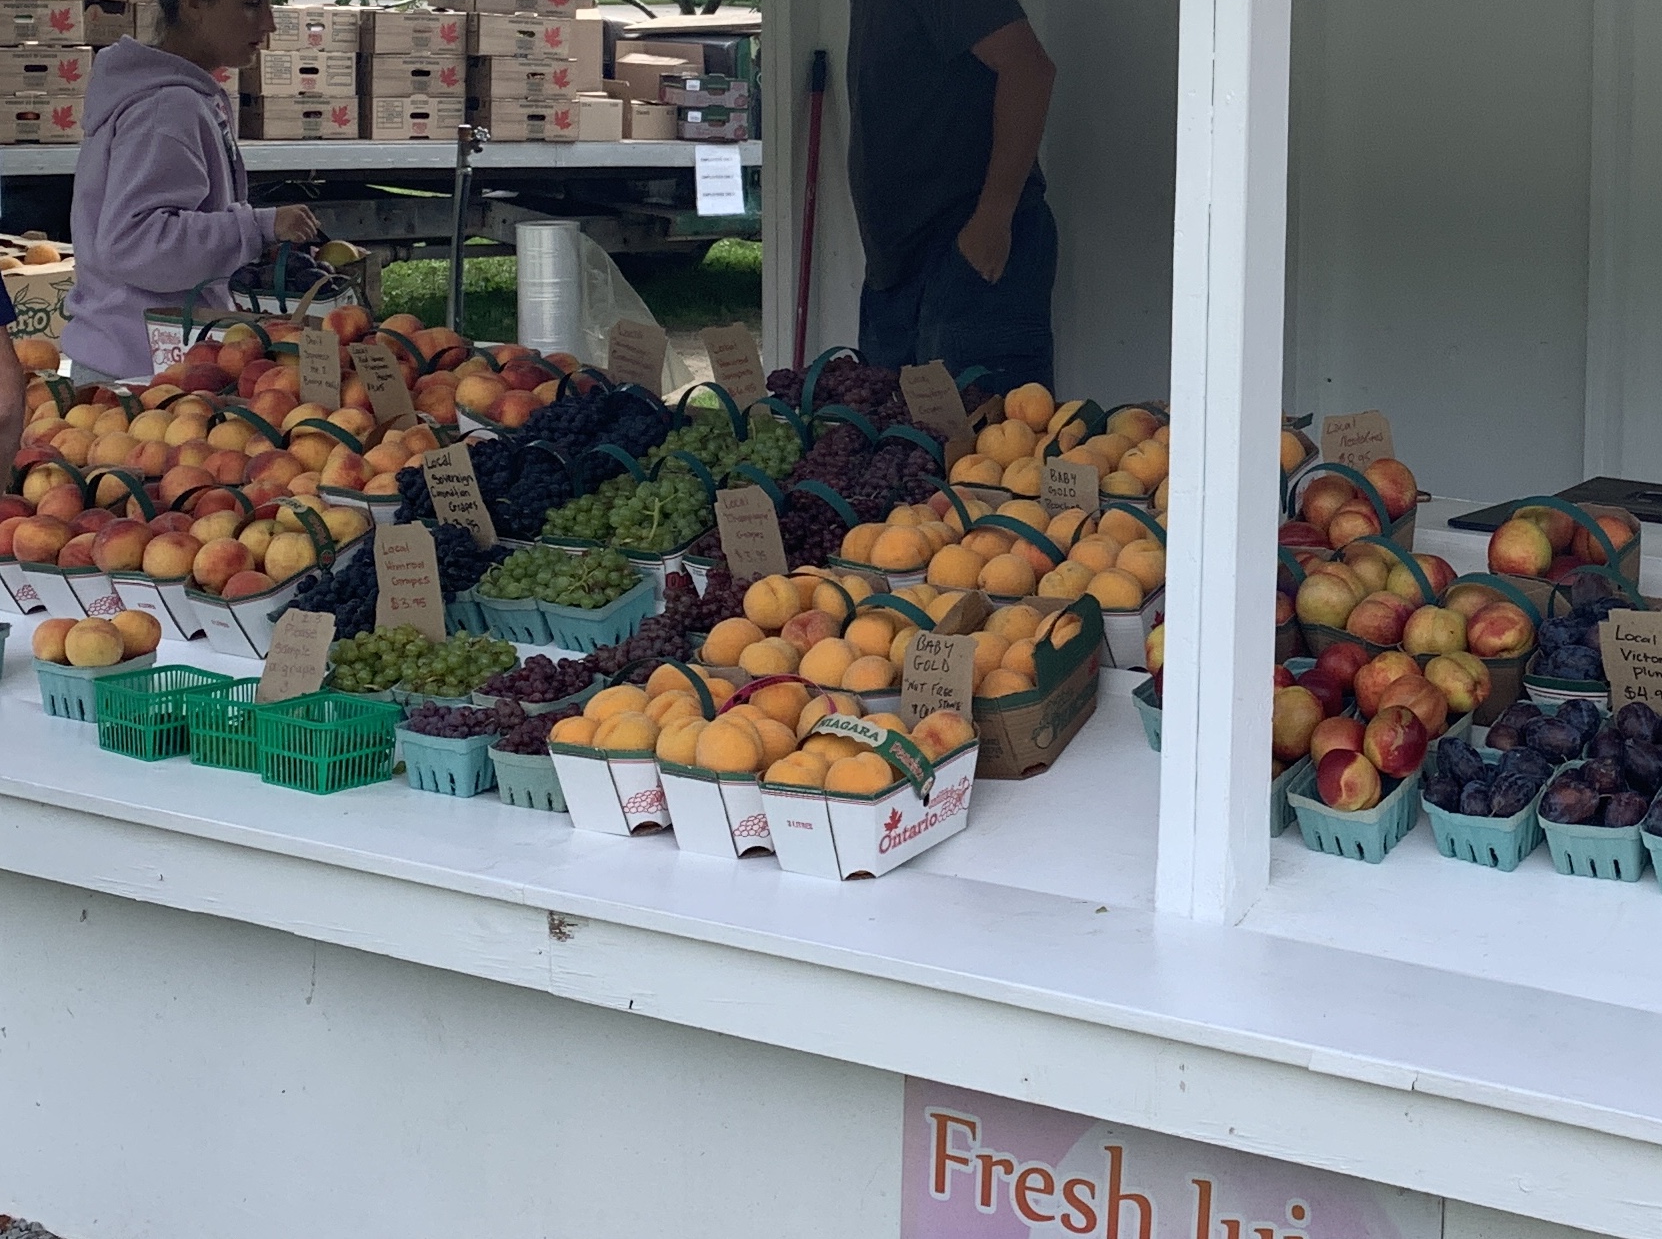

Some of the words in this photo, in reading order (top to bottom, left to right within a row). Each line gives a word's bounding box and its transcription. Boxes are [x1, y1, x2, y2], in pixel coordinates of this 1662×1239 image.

[424, 452, 451, 469] Local
[916, 634, 954, 658] BABY
[1616, 625, 1657, 645] Local
[914, 656, 950, 672] GOLD
[818, 717, 880, 743] NIAGARA
[878, 811, 938, 855] Ontario
[930, 1112, 1153, 1239] Fresh
